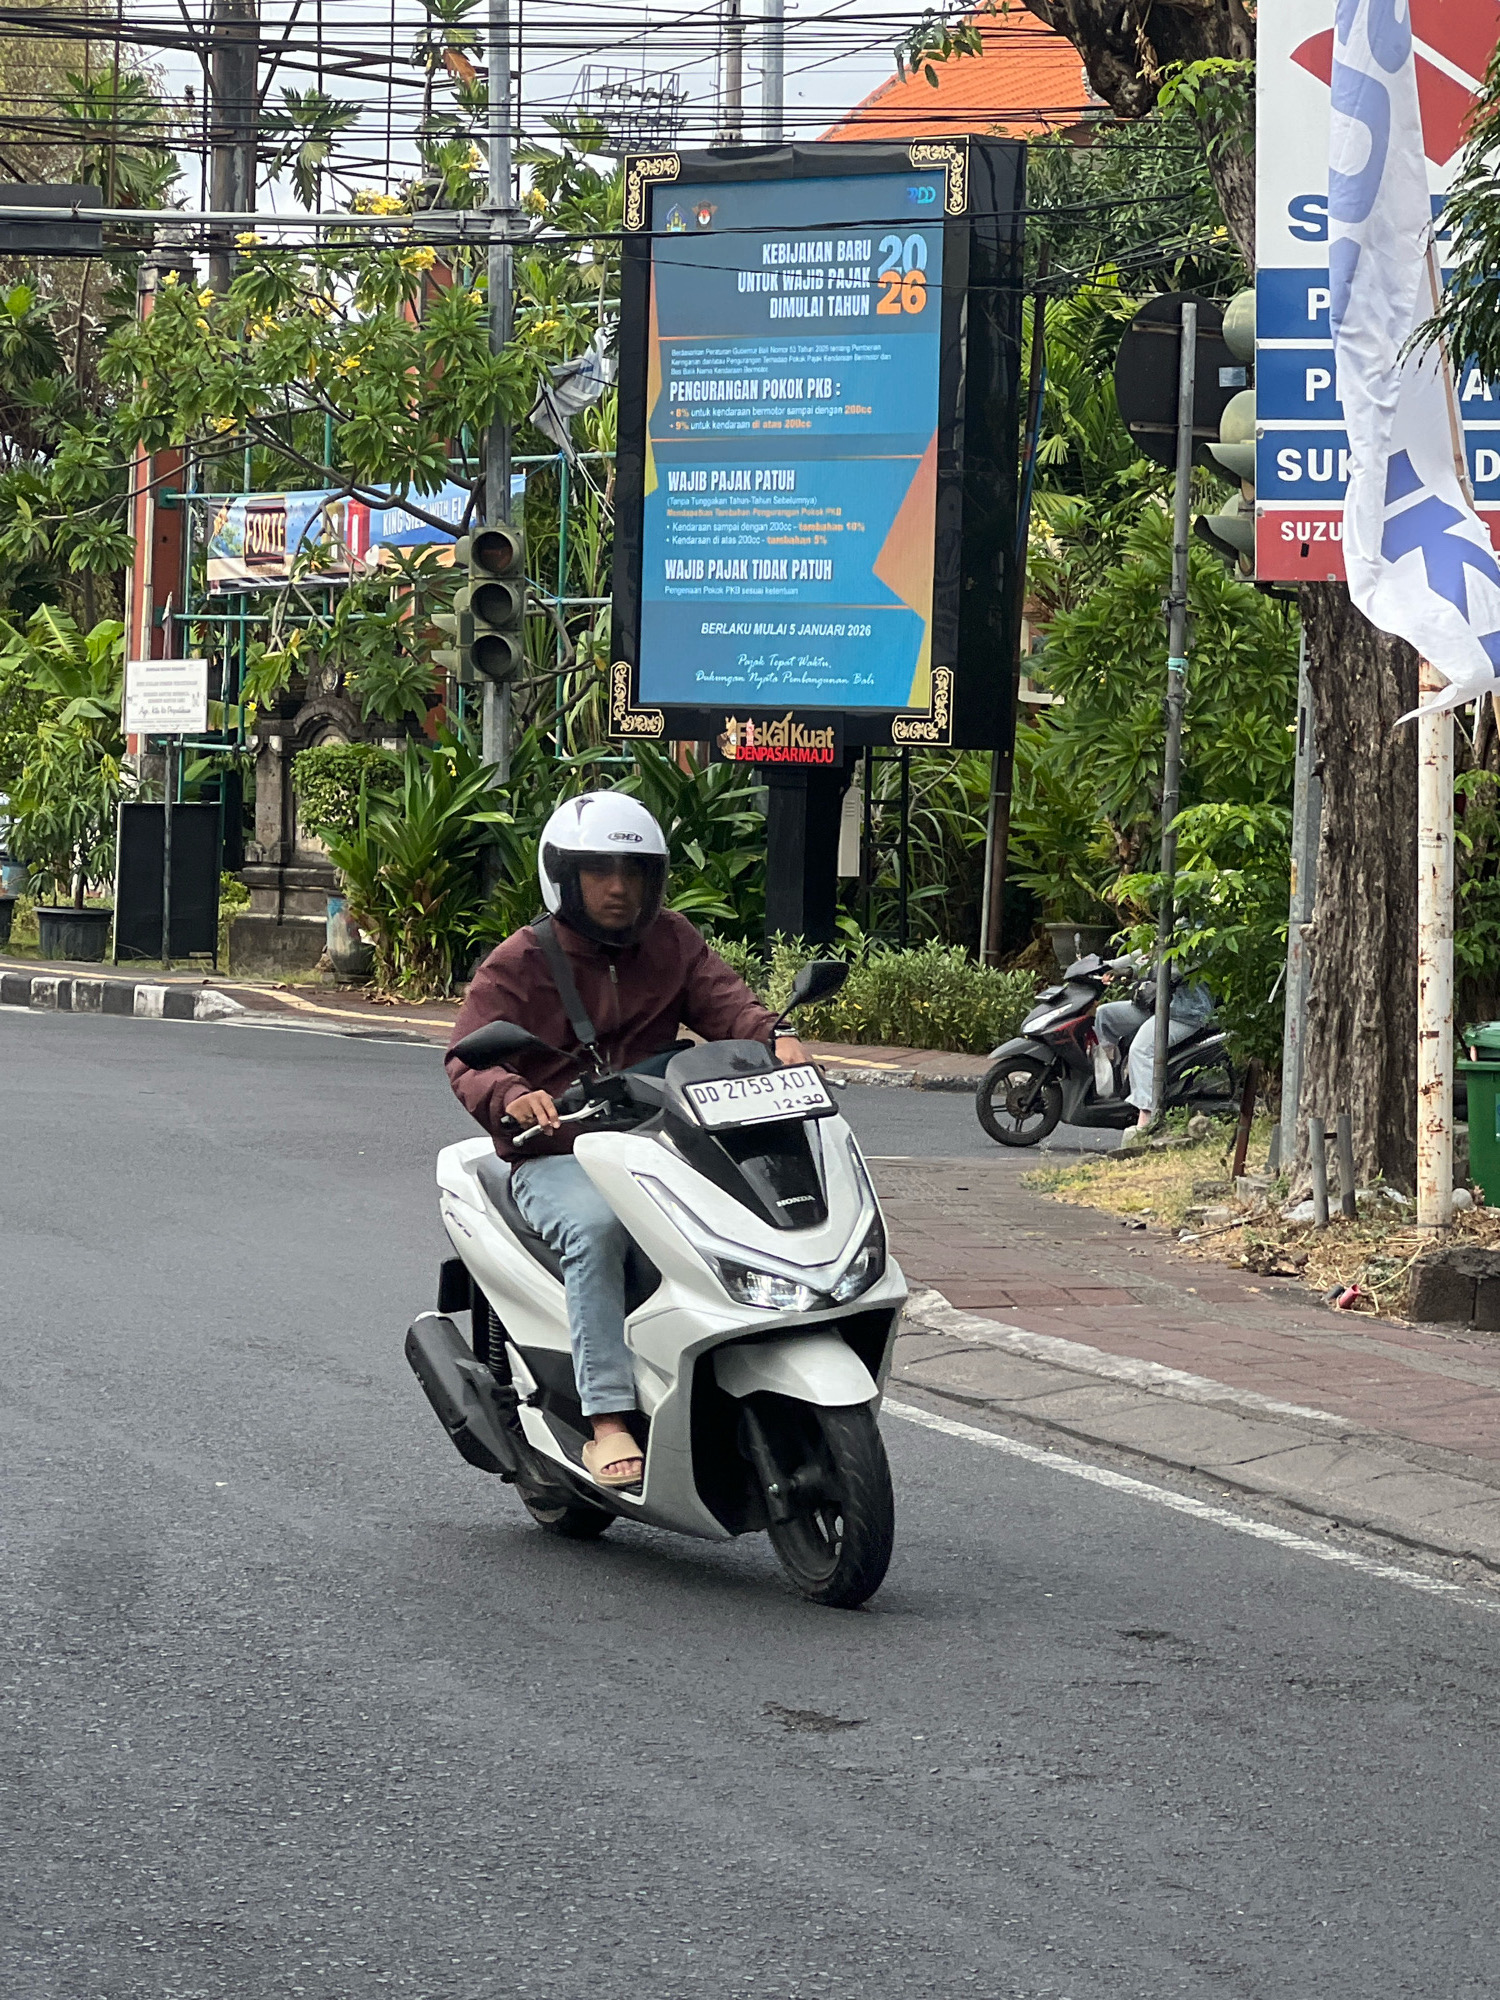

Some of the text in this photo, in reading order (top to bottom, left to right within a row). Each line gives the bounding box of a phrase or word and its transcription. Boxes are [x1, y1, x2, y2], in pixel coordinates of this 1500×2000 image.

[762, 240, 871, 264] KEBIJAKAN BARU
[737, 266, 871, 292] UNTUK WAJIB PAJAK
[876, 270, 927, 314] 26
[770, 294, 870, 318] DIMULAI TAHUN
[670, 380, 759, 402] PENGURANGAN
[762, 379, 804, 400] POKOK
[807, 378, 833, 398] PKB
[691, 408, 710, 417] untuk
[712, 407, 750, 416] kendaraan
[752, 406, 786, 416] bermotor
[787, 405, 814, 416] sampai
[815, 405, 842, 416] dengan
[690, 421, 710, 430] untuk
[712, 420, 750, 429] kendaraan
[668, 470, 795, 492] WAJIB PAJAK PATUH
[692, 496, 728, 506] Tunggakan
[246, 512, 286, 555] FORTE
[383, 509, 403, 537] KING
[672, 522, 712, 531] Kendaraan
[713, 522, 740, 532] sampai
[740, 522, 768, 533] dengan
[770, 522, 792, 531] 200cc
[1281, 521, 1343, 541] SUZU
[672, 536, 711, 544] Kendaraan
[712, 535, 720, 544] di
[721, 536, 737, 544] atas
[738, 534, 760, 544] 200cc
[664, 559, 832, 580] WAJIB PAJAK TIDAK PATUH
[700, 622, 872, 637] BERLAKU MULAI 5 JANUARI 2026
[693, 1070, 816, 1104] DD 2759 XDI
[776, 1195, 816, 1207] HONDA
